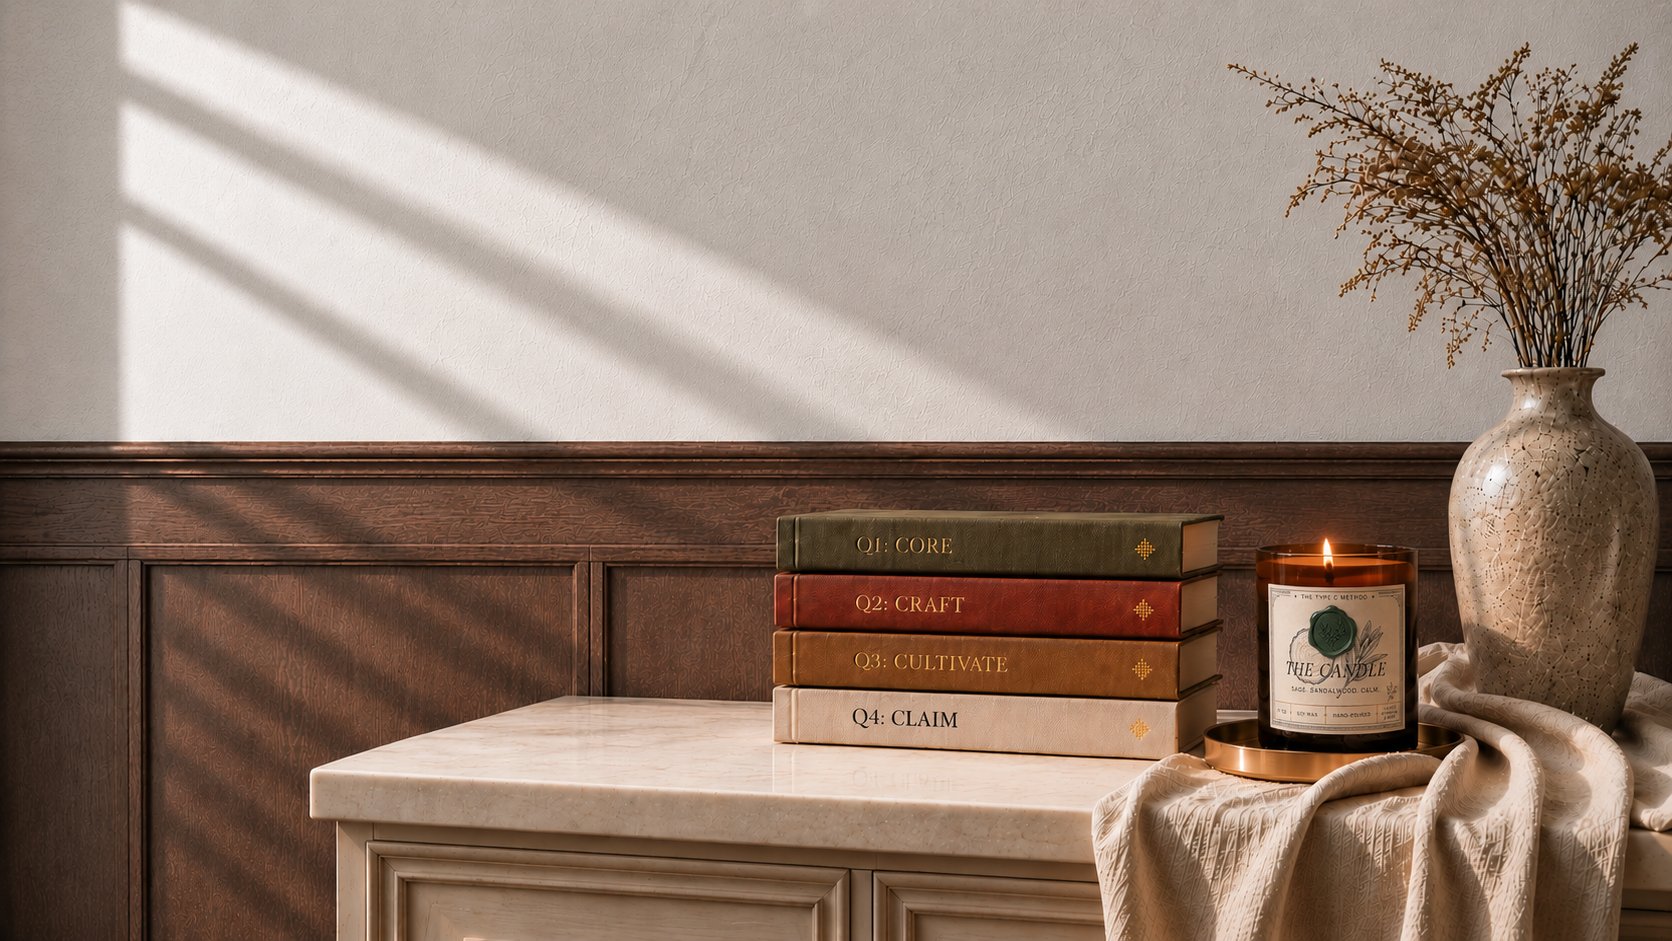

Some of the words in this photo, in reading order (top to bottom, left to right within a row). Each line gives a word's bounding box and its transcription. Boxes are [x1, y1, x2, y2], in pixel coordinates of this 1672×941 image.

[856, 536, 888, 556] Q1:
[895, 536, 953, 554] CORE
[855, 595, 888, 614] Q2:
[895, 595, 965, 614] CRAFT
[854, 652, 887, 671] Q3:
[893, 653, 1008, 673] CULTIVATE
[1286, 660, 1314, 677] THE
[1320, 661, 1387, 678] CANDLE
[852, 708, 885, 729] Q4:
[891, 709, 958, 728] CLAIM
